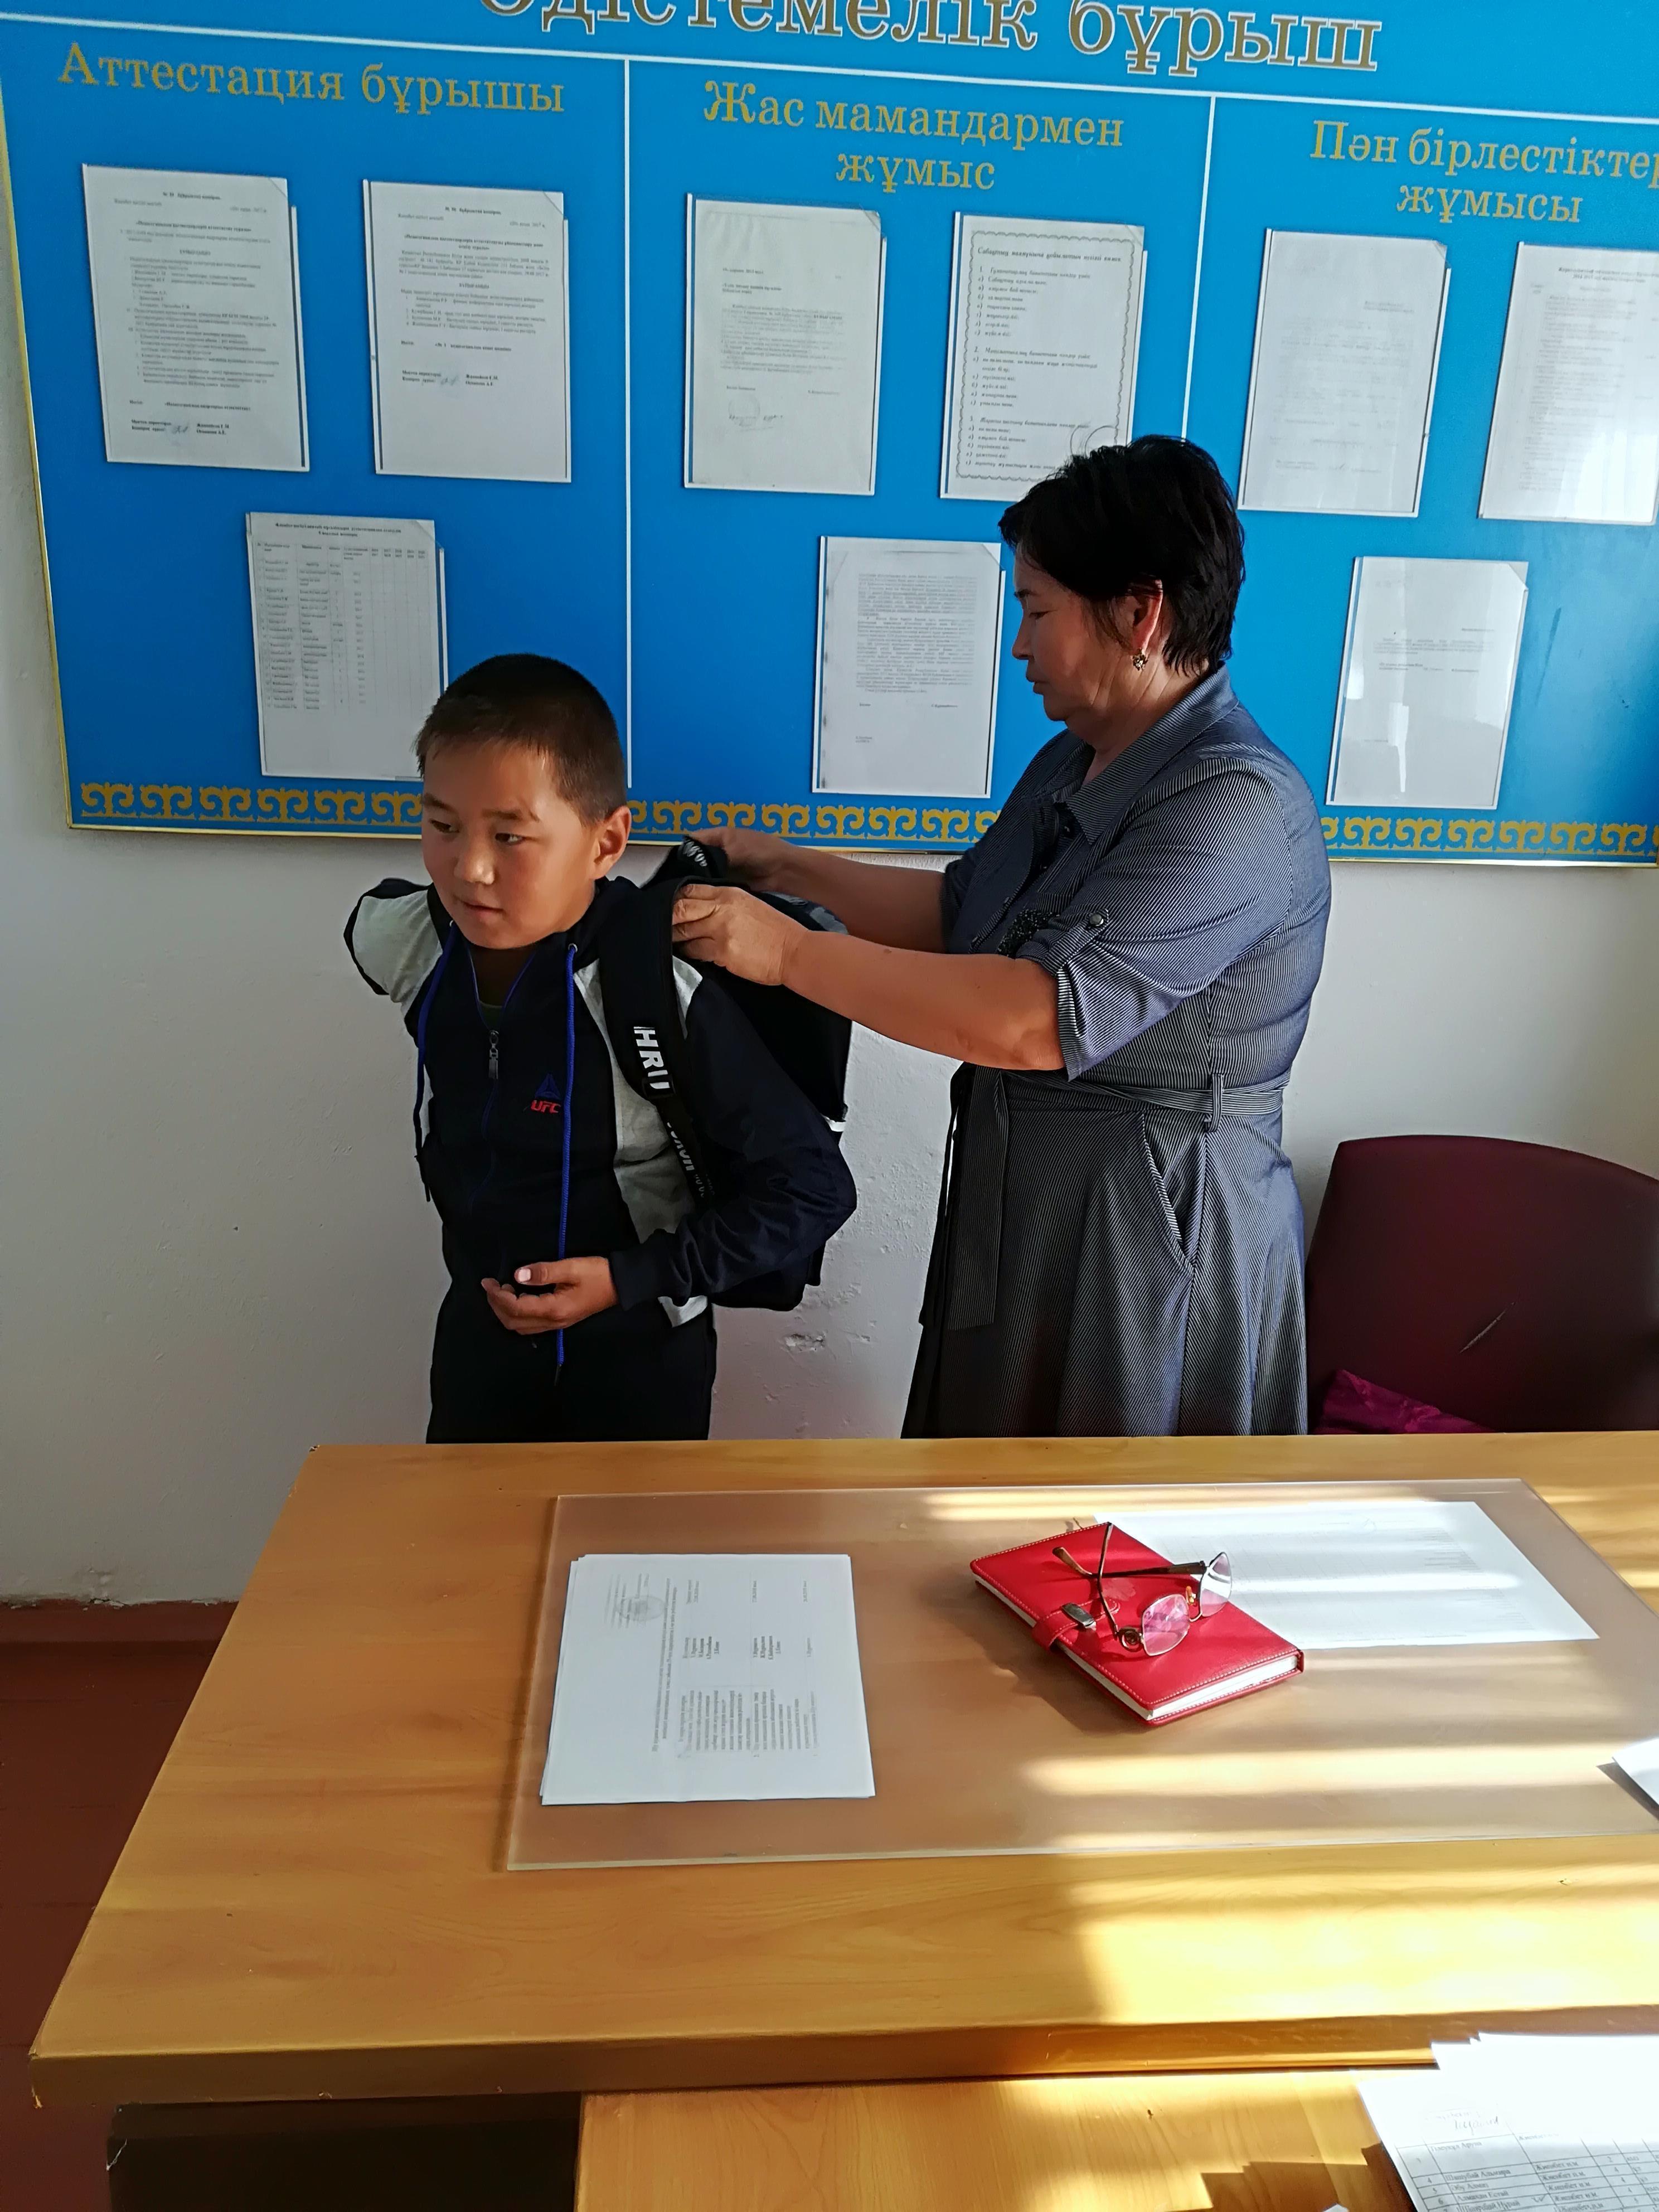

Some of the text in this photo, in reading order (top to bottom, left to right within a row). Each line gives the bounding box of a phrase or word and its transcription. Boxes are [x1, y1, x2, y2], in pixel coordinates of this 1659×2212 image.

[479, 0, 1382, 77] дстемелік бұрыш
[58, 42, 564, 115] Аттестация бұрышы
[704, 80, 1123, 151] Жас мамандармен
[1310, 120, 1398, 163] Пән
[836, 153, 995, 193] жұмыс
[1396, 185, 1583, 223] жұмысы
[531, 1099, 562, 1114] UFC
